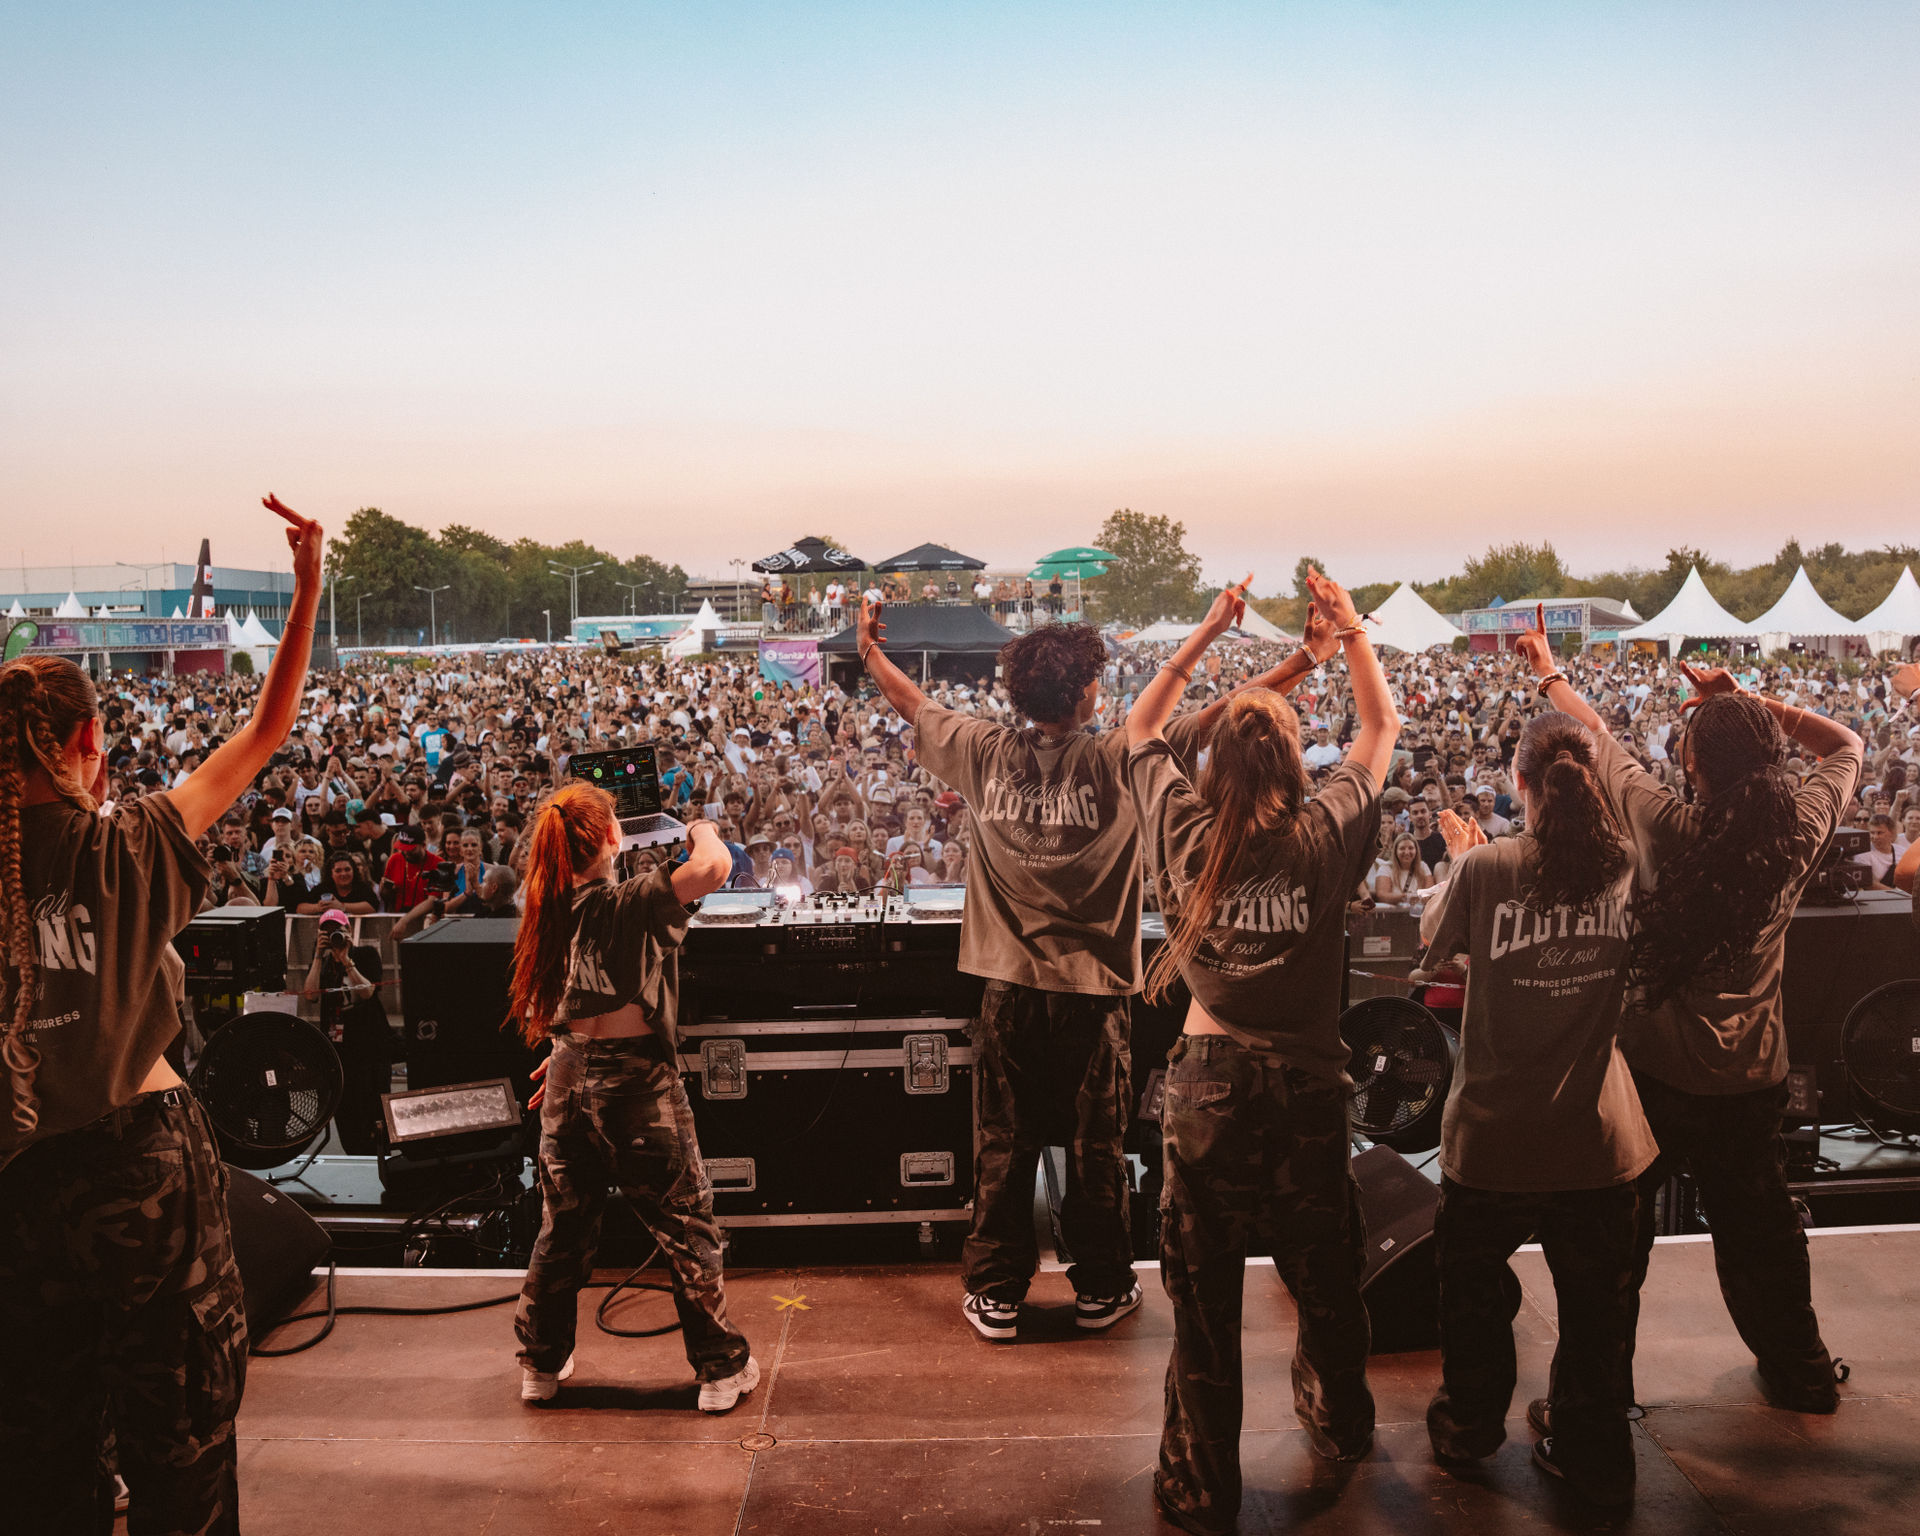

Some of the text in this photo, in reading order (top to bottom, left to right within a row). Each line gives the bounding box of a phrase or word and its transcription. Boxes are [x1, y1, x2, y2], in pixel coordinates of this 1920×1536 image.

[979, 777, 1100, 831] CLOTHING
[1035, 834, 1062, 849] 1988
[1214, 885, 1309, 934] THING
[1231, 942, 1266, 956] 1988
[1537, 946, 1600, 969] Est. 1988
[1198, 954, 1220, 967] RICE
[1221, 962, 1236, 971] OF
[1512, 968, 1616, 988] THE PRICE OF PROGRESS
[1550, 986, 1582, 997] IS PAIN.
